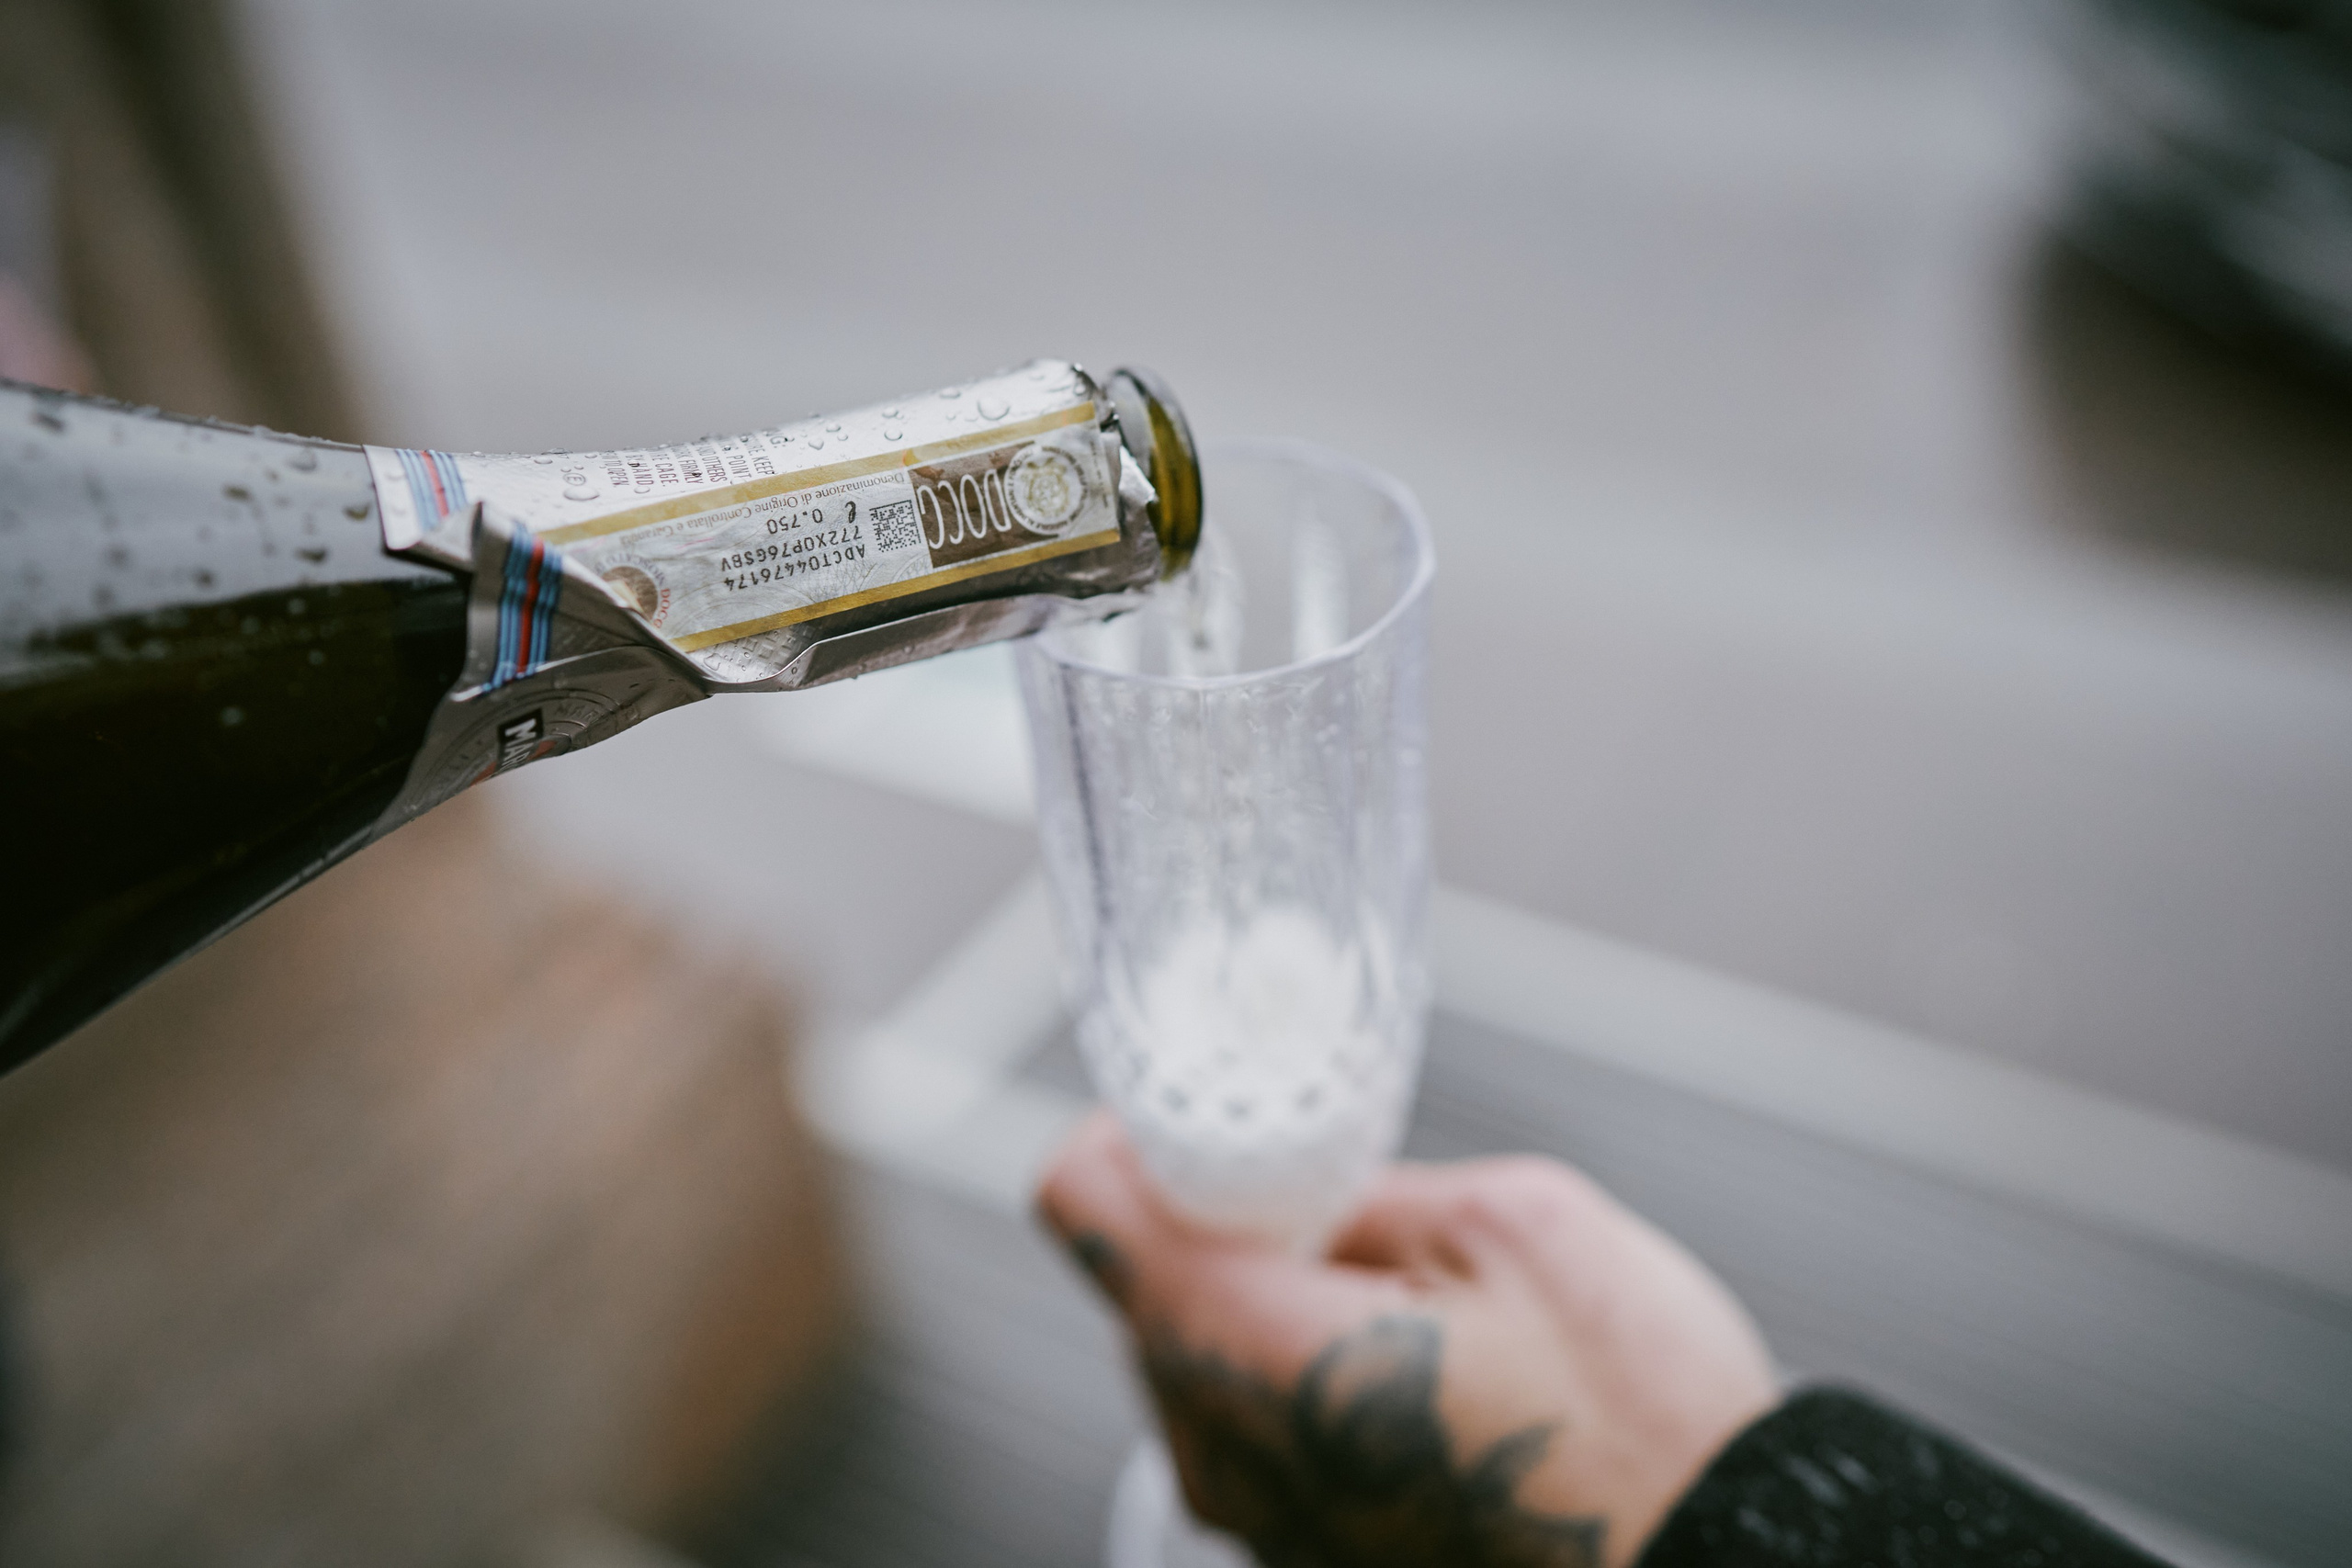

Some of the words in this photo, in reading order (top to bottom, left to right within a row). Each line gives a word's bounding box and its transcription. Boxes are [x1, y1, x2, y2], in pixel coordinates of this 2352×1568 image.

[655, 463, 679, 487] CAGE.
[702, 456, 728, 483] OTHERS
[726, 454, 752, 479] POINT
[802, 493, 812, 505] di
[814, 472, 905, 500] Denominazione
[755, 495, 797, 513] Origine
[916, 468, 1012, 549] DOCG
[688, 505, 752, 531] Controllata
[766, 509, 823, 536] 0.750
[501, 718, 537, 769] MAR
